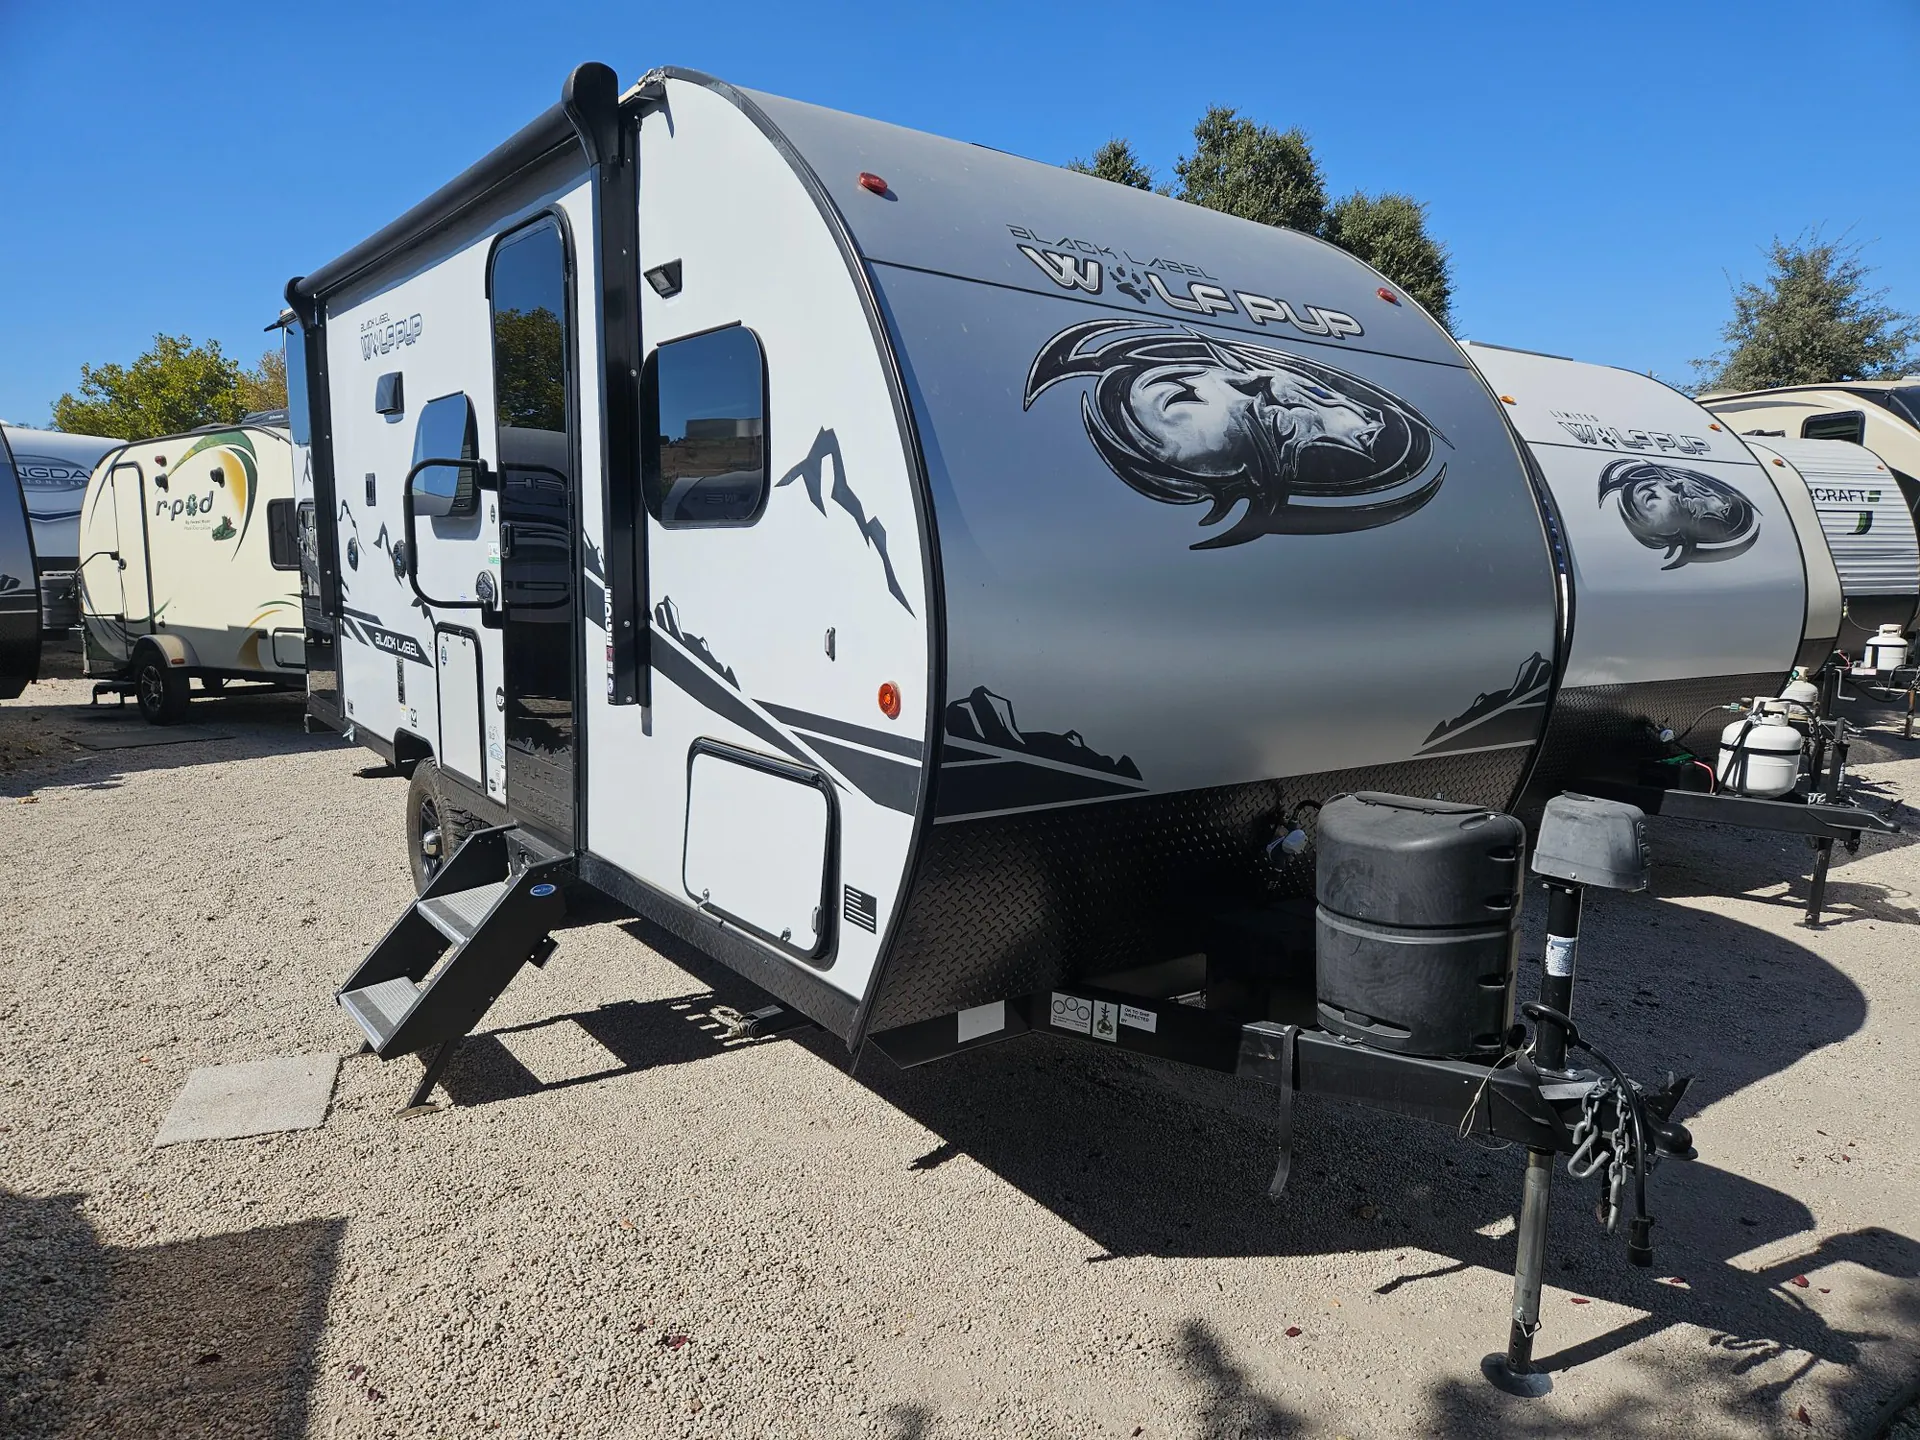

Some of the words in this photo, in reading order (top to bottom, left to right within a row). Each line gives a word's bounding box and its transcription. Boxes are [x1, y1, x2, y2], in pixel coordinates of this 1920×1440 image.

[1006, 223, 1118, 260] BLACK
[1123, 248, 1218, 281] LABEL
[1016, 243, 1238, 317] WOLF
[1233, 289, 1365, 340] PUP
[395, 313, 423, 350] PUP
[1648, 431, 1711, 456] PUP
[17, 466, 94, 480] NGDA
[375, 632, 396, 650] BLACK
[396, 638, 420, 658] LABEL
[1124, 1013, 1149, 1022] INSPECTED
